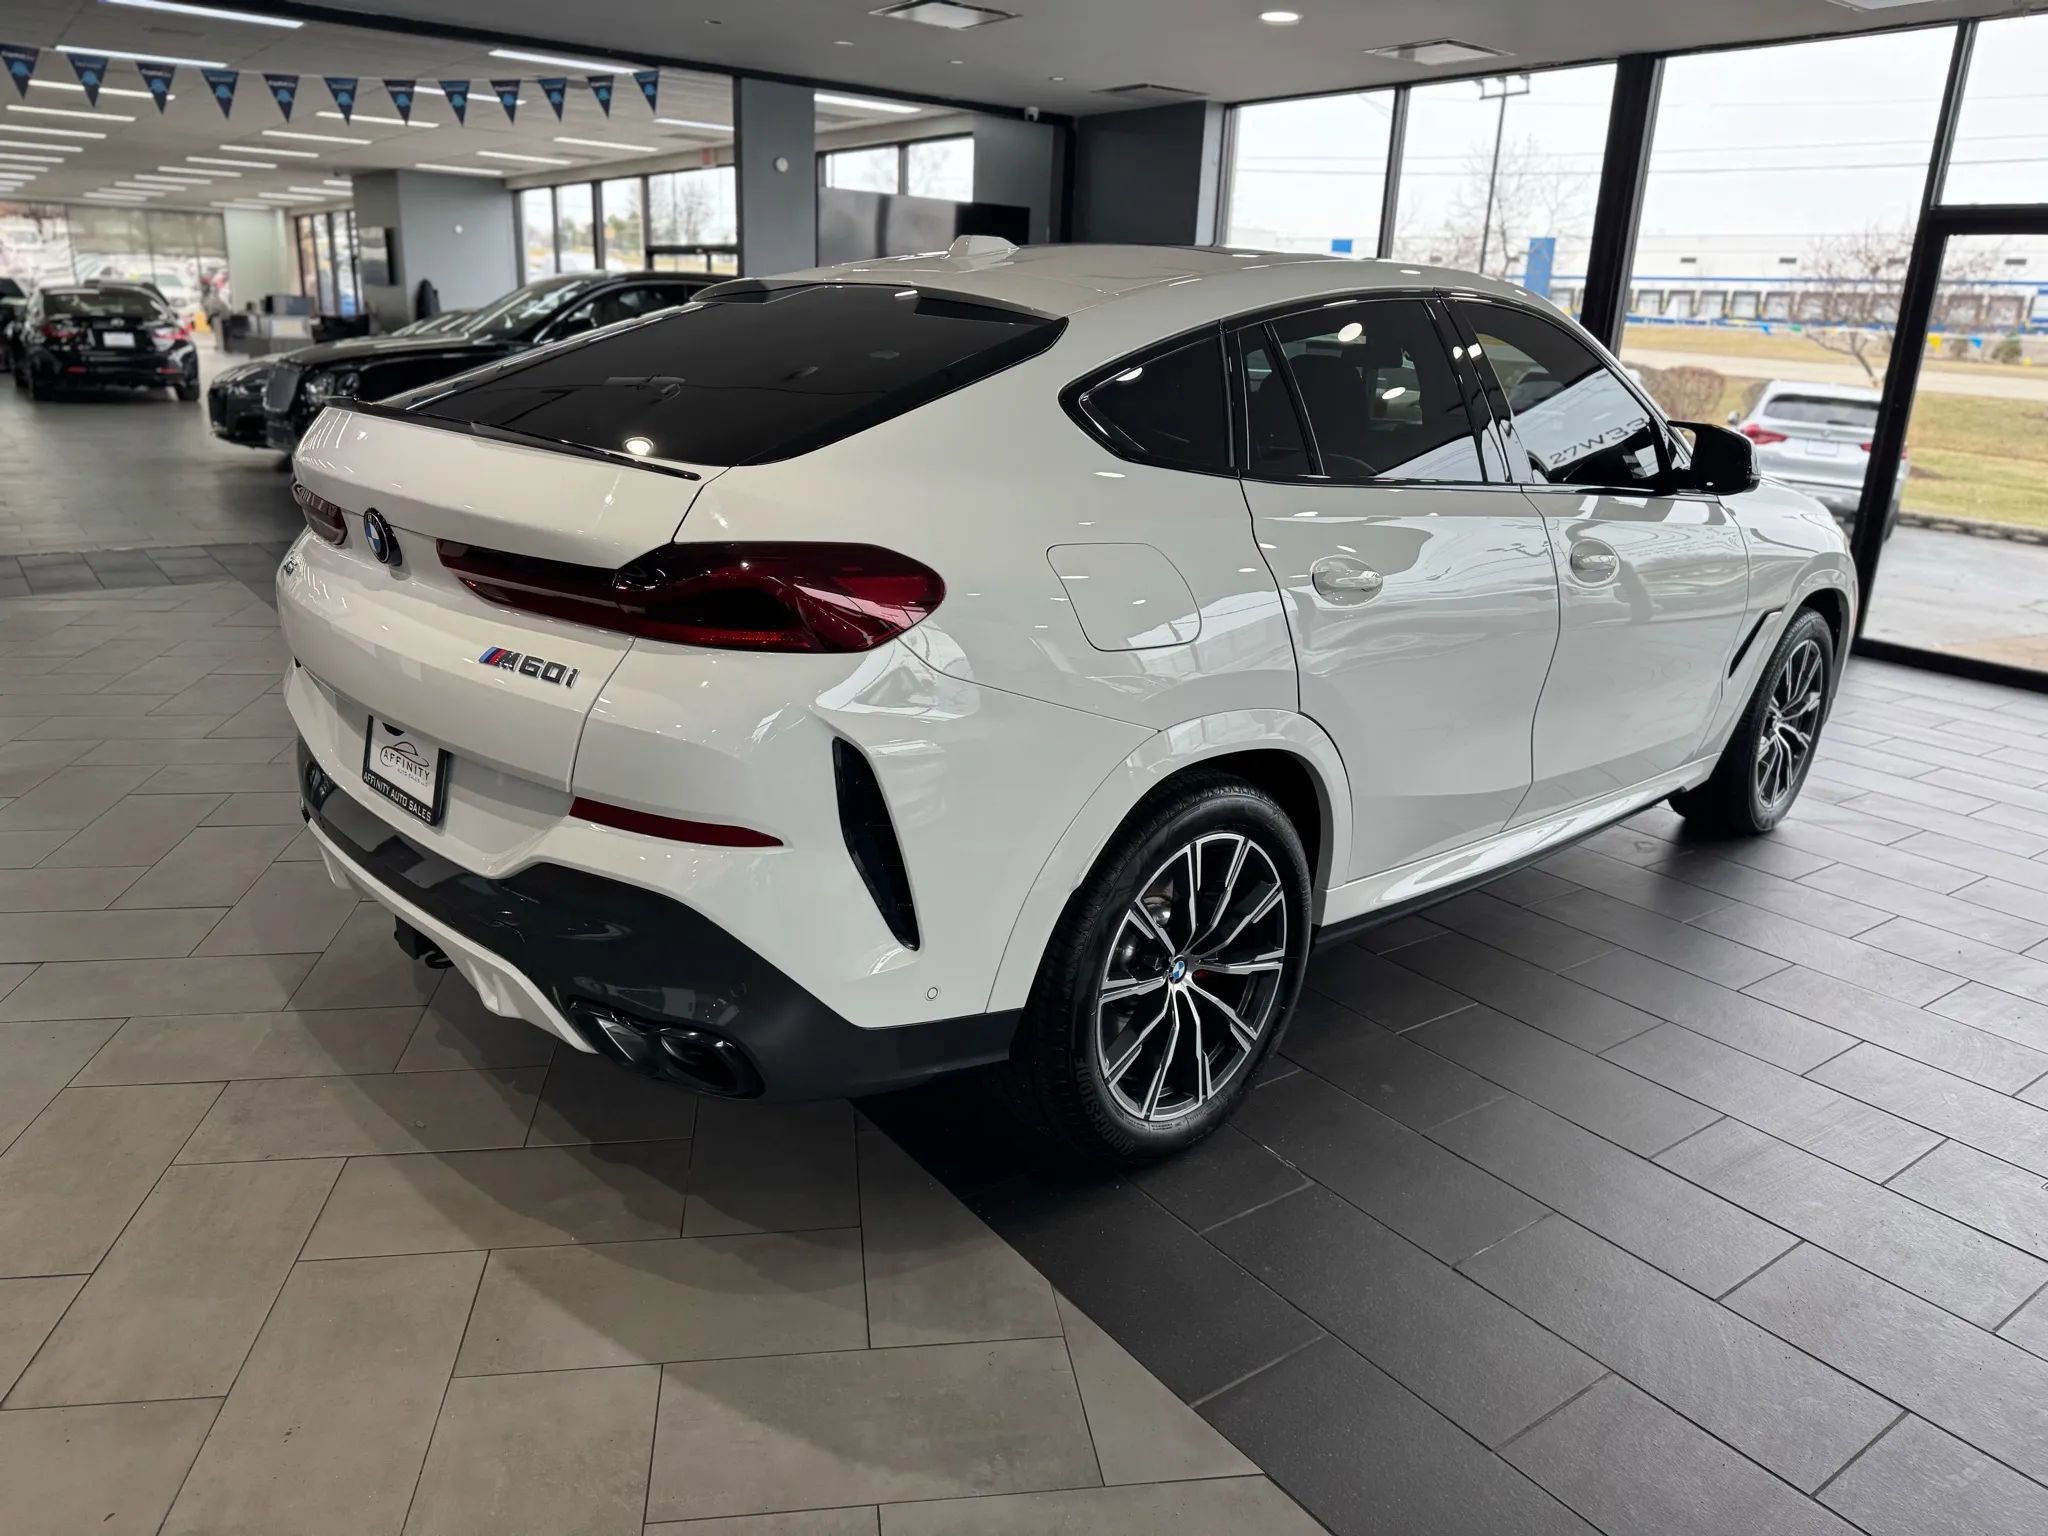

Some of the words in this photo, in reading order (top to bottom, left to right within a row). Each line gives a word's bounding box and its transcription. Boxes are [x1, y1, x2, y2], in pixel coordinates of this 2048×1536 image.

[480, 646, 580, 688] M60i
[382, 749, 430, 780] AFFINITY
[363, 772, 391, 796] AFFINITY
[391, 789, 408, 807] AUTO
[409, 800, 431, 822] SALES
